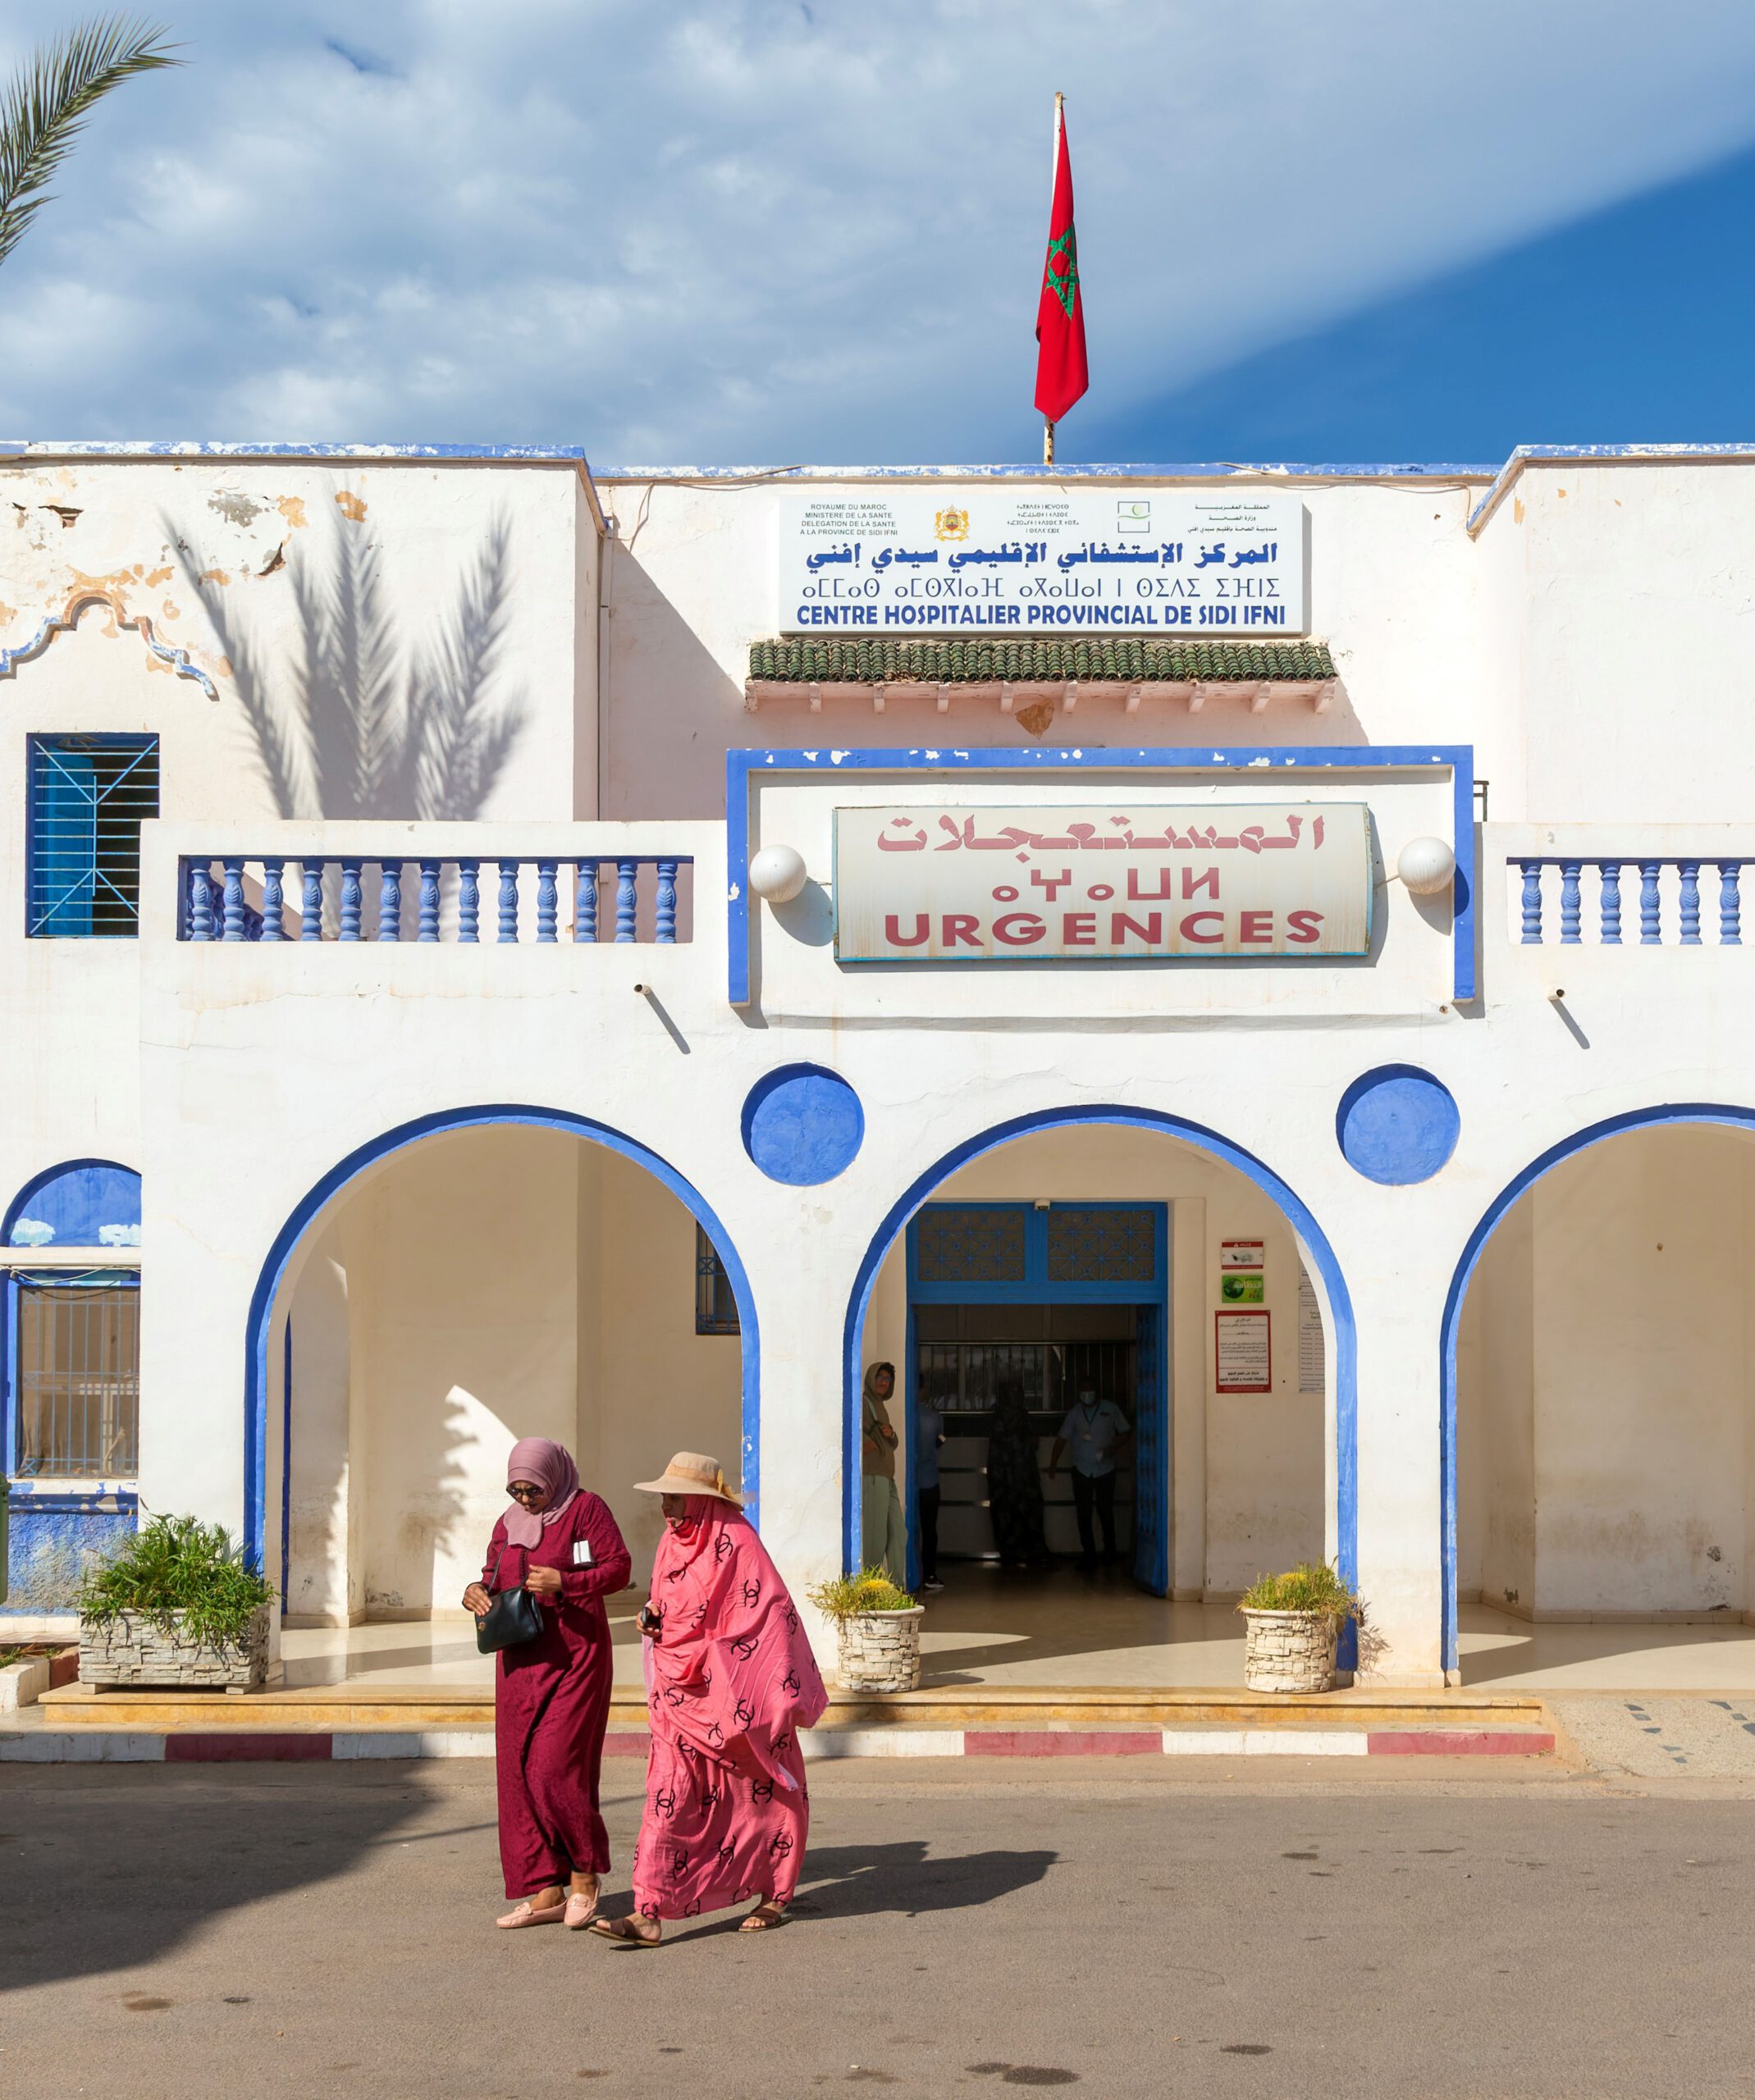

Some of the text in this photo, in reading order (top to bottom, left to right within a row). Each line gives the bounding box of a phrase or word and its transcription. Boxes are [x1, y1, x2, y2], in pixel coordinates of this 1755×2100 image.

[806, 541, 1277, 575] المركز الإستشفائي الإقليمي سيدي إفني
[798, 605, 1286, 626] CENTRE HOSPITALIER PROVINCIAL DE SIDI IFNI
[878, 814, 1324, 864] المستعجلات
[885, 911, 1323, 947] URGENCES
